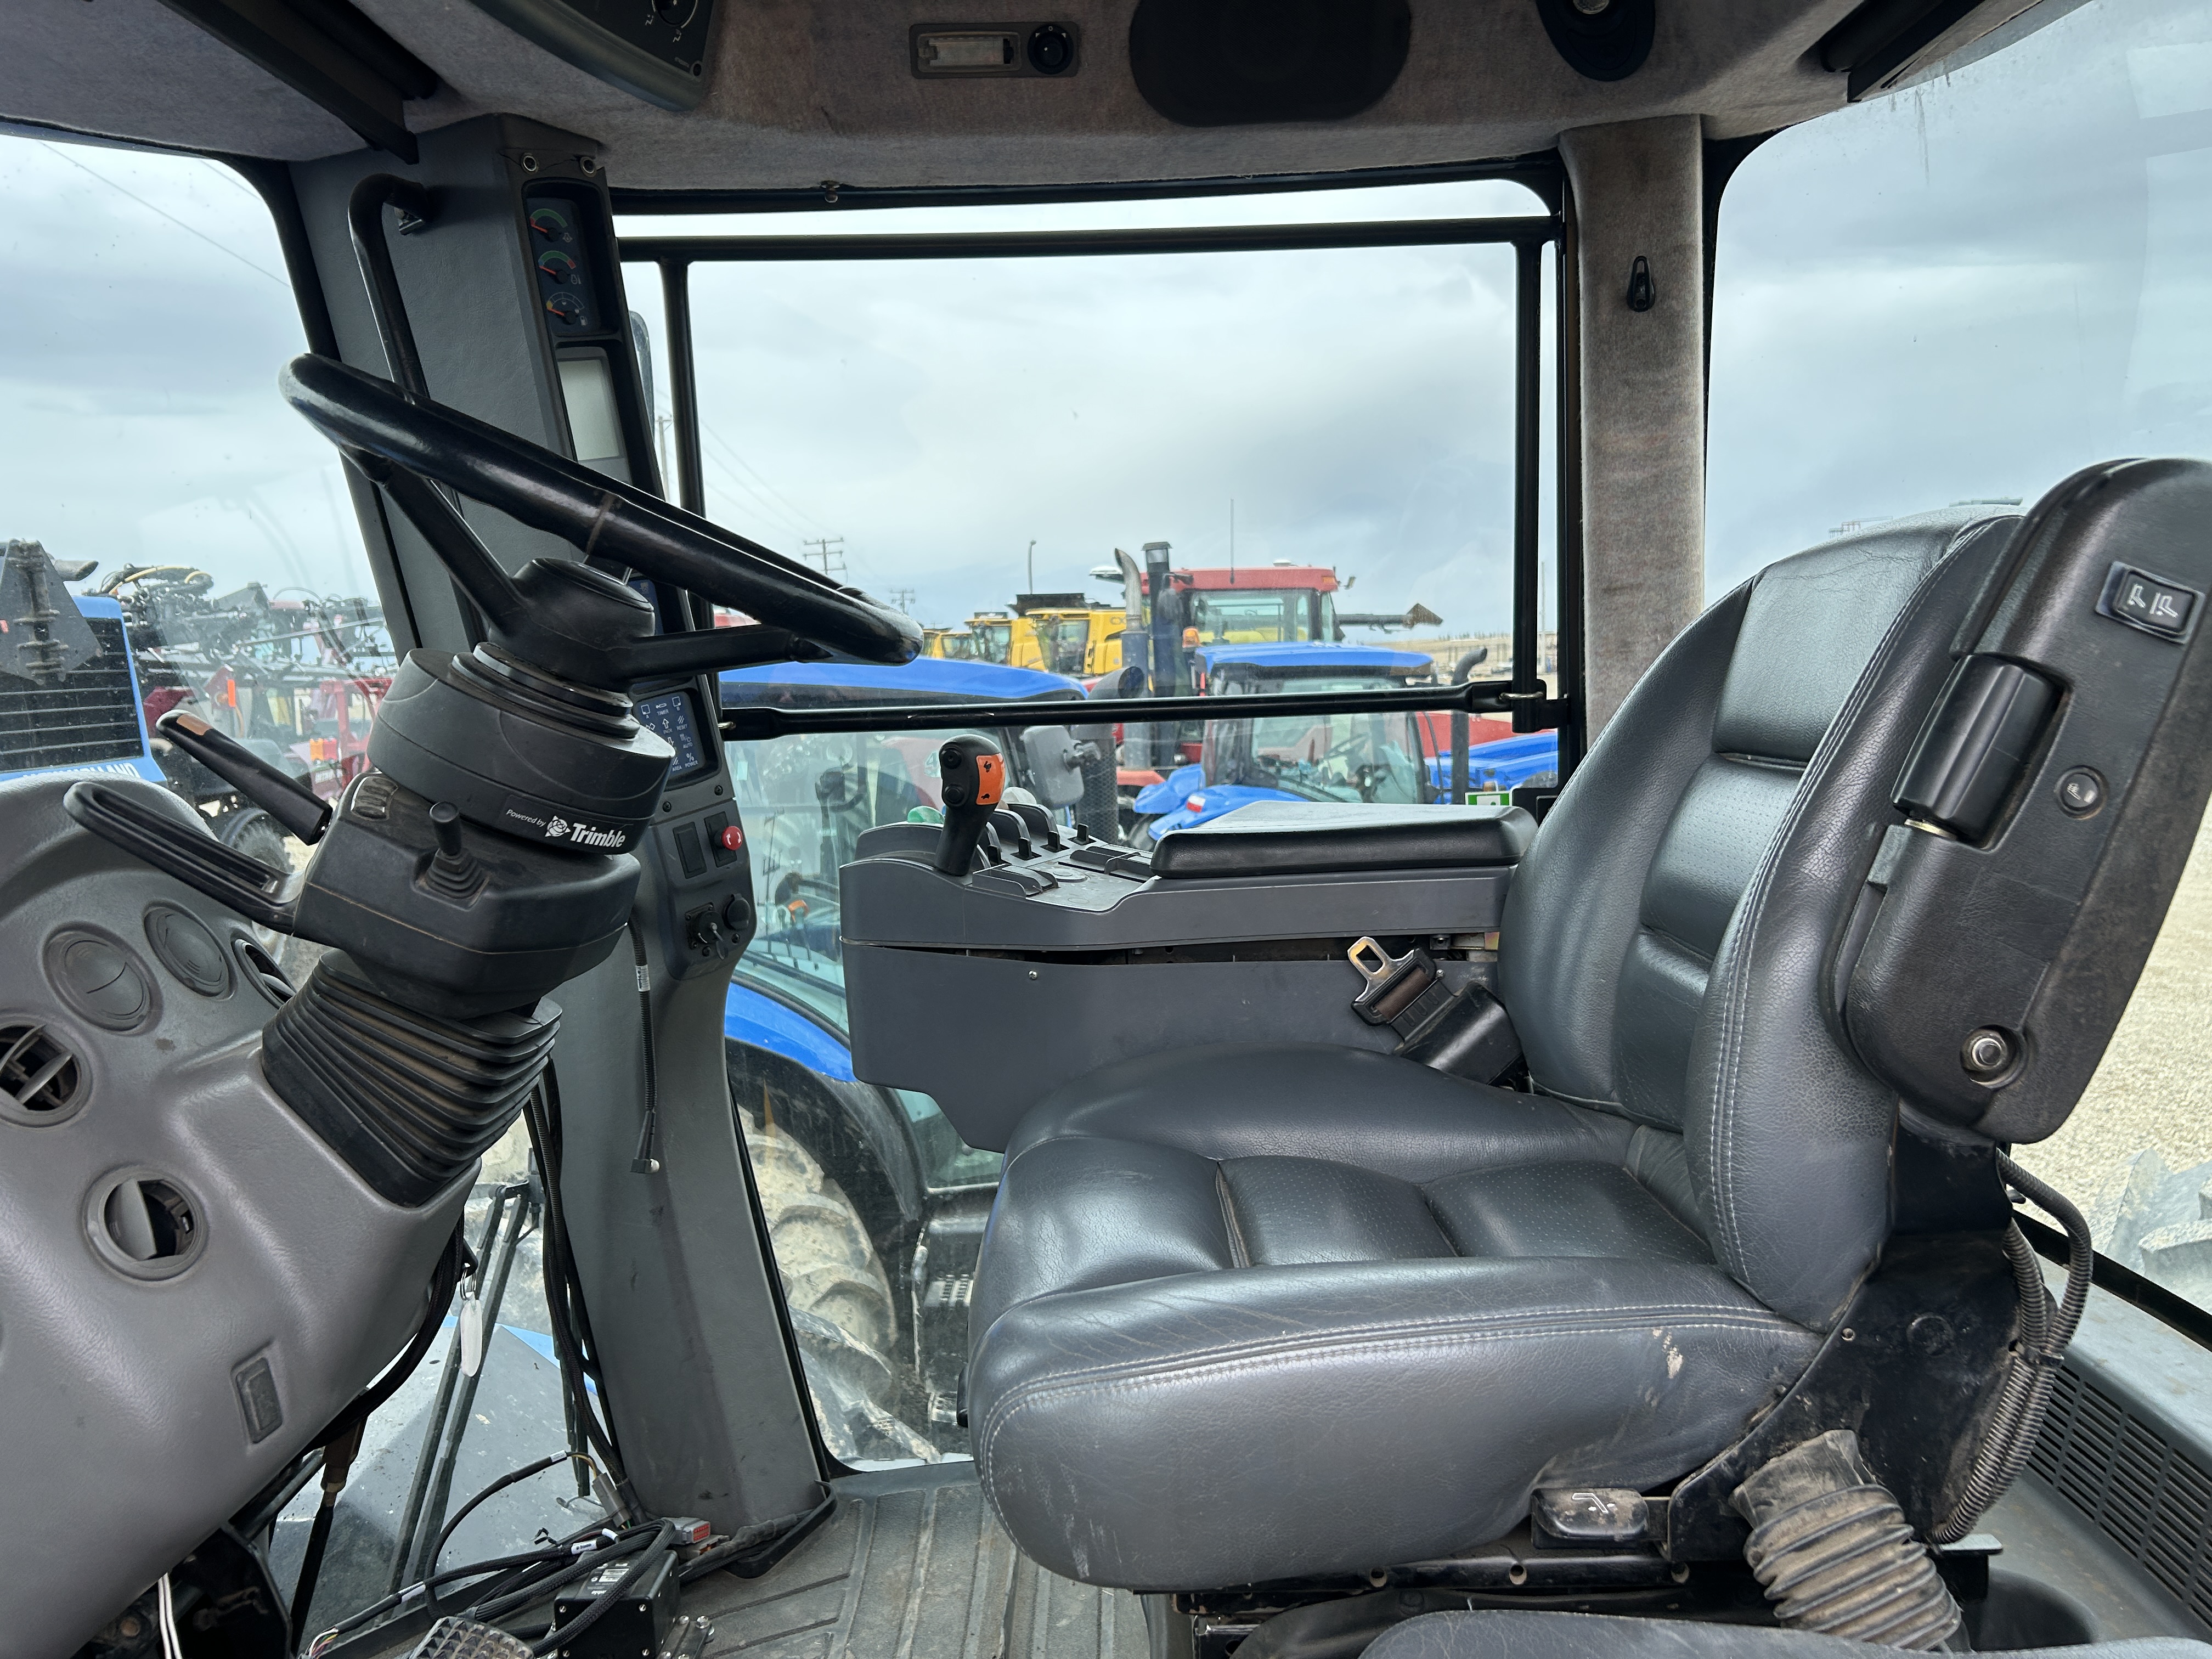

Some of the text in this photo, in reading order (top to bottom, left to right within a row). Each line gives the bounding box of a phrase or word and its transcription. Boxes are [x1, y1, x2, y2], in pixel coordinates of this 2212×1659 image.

[506, 809, 546, 827] Powered by
[570, 823, 626, 848] Trimble
